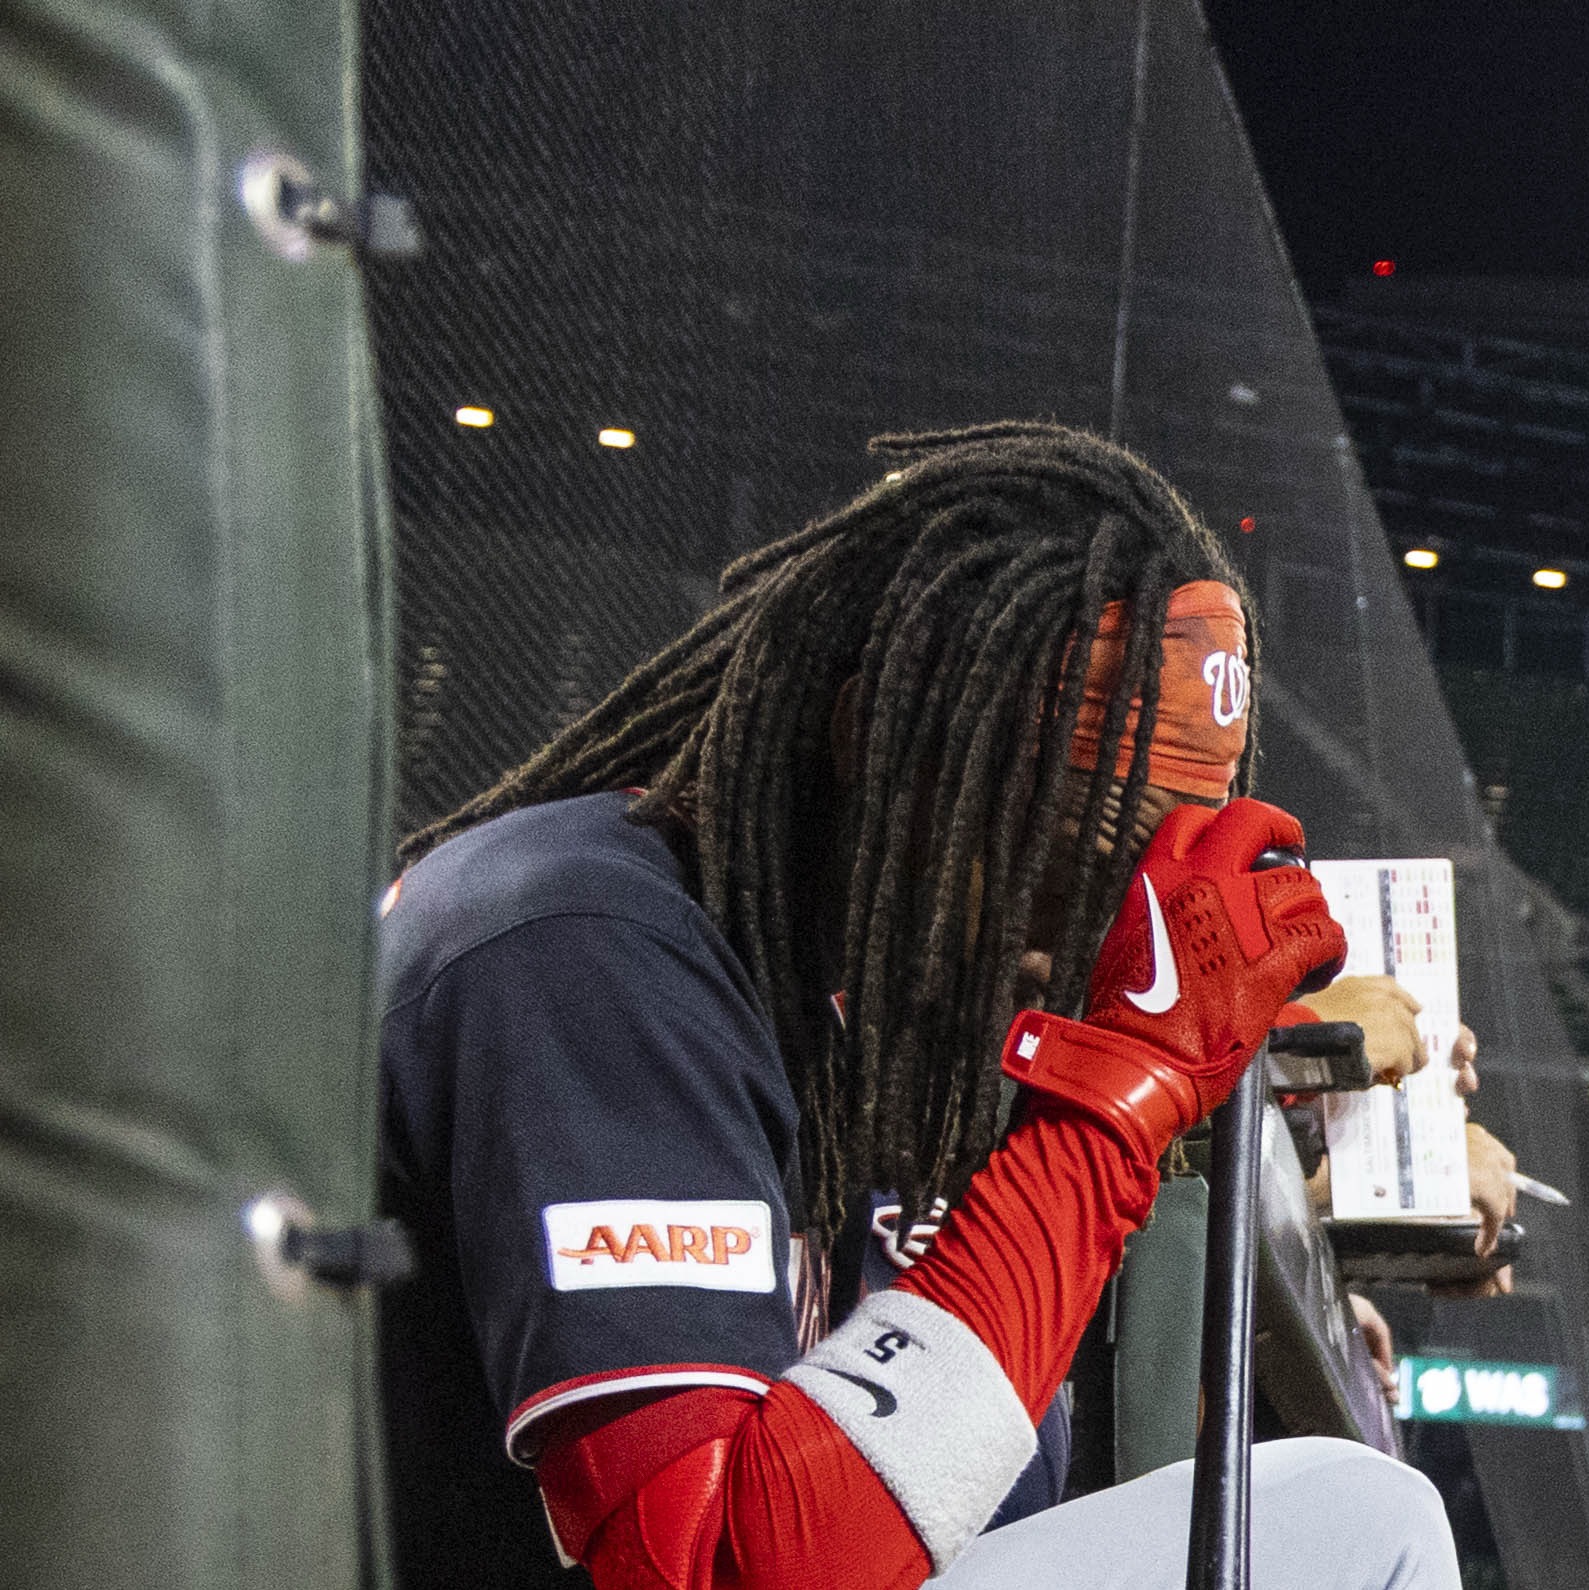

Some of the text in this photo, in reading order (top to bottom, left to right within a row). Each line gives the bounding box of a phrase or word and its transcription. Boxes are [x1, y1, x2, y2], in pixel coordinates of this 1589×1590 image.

[558, 1223, 755, 1266] AARP
[863, 1330, 910, 1365] 5
[1464, 1369, 1550, 1418] WAS
